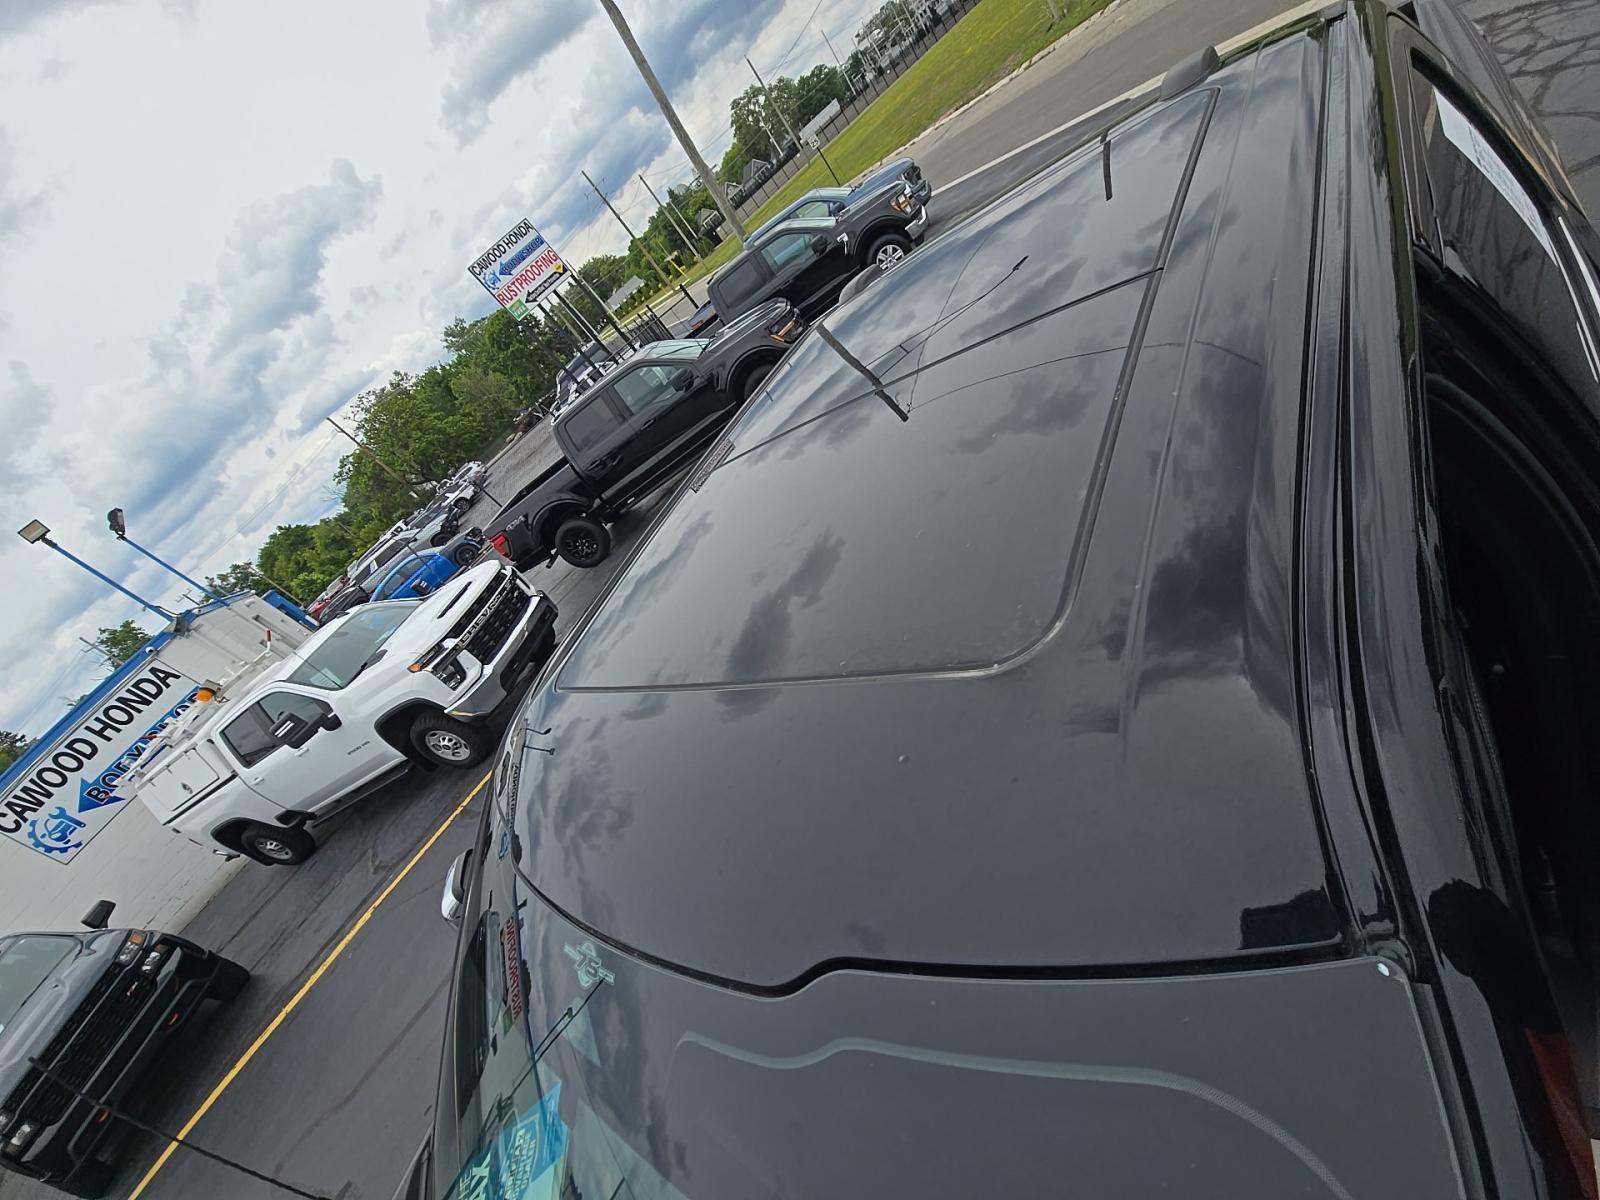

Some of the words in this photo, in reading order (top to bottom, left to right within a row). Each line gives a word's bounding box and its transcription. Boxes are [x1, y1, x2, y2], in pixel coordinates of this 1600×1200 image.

[472, 243, 507, 277] CAWOOD
[503, 221, 533, 250] HONDA
[496, 249, 558, 306] RUSTPROOFING
[0, 737, 99, 834] CAWOOD
[84, 666, 182, 743] HONDA
